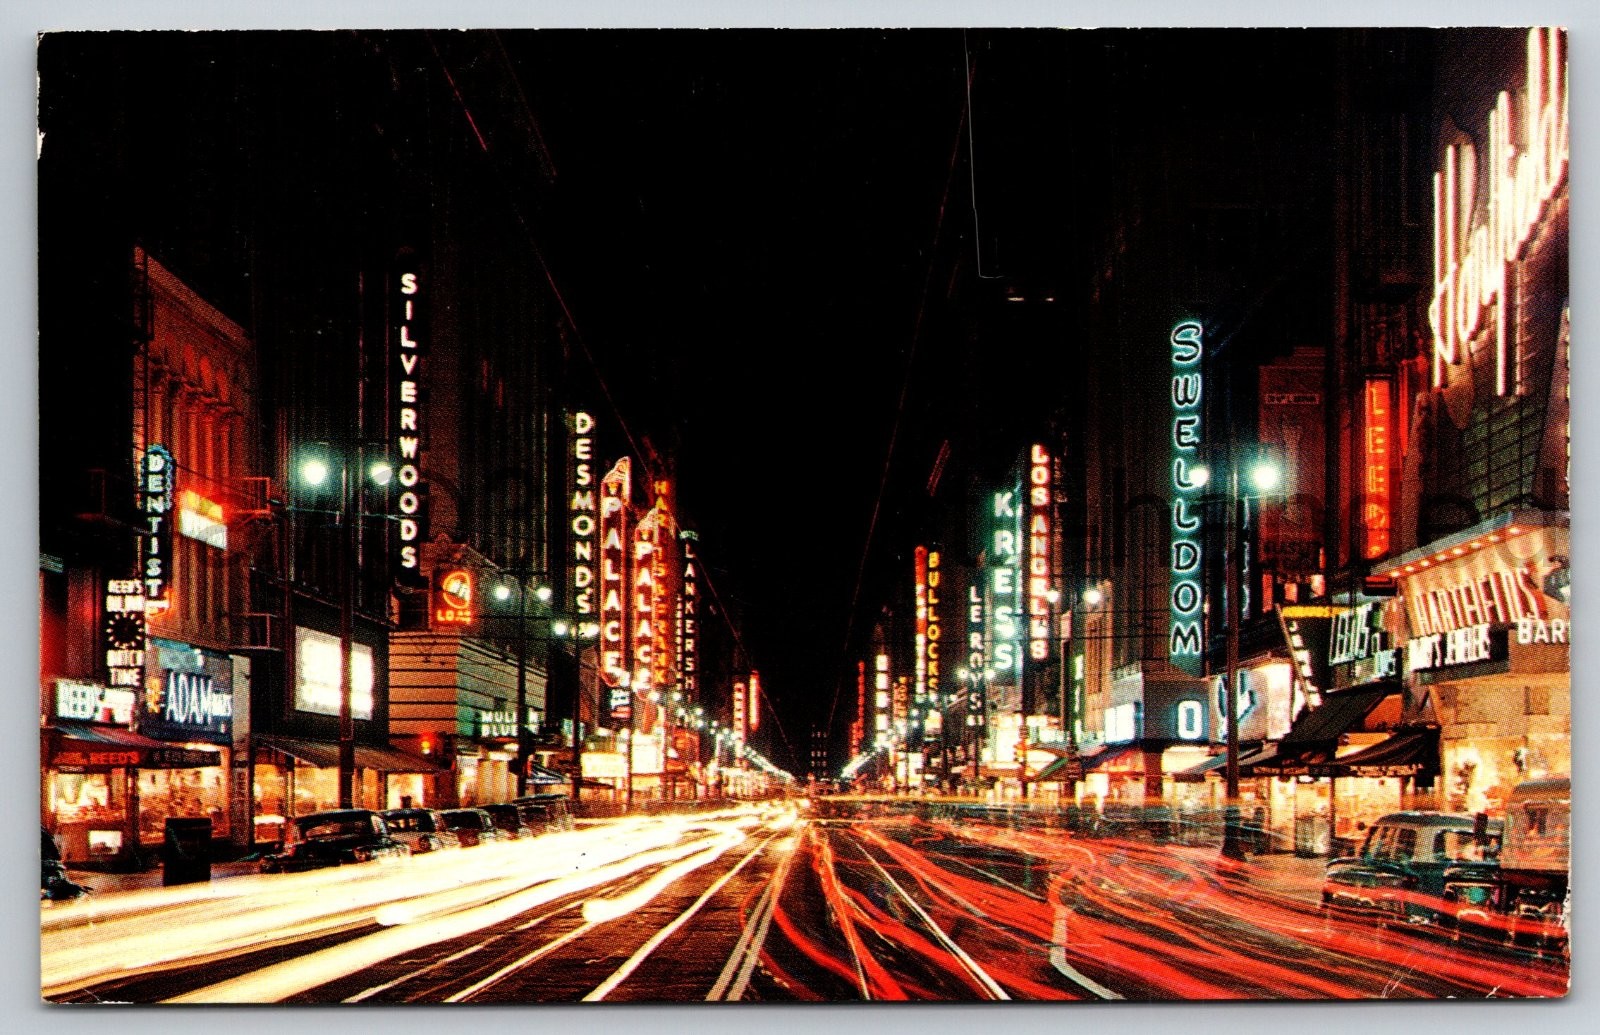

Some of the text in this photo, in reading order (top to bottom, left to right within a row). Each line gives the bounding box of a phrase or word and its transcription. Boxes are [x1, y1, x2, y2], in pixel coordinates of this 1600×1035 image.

[399, 272, 418, 568] SILVERWOODS
[1170, 321, 1203, 656] SWELLDOM
[145, 453, 166, 598] DENTIST
[571, 411, 597, 614] DESMOND'S
[601, 496, 622, 675] PALACE
[993, 492, 1014, 670] KRESS
[1030, 443, 1050, 660] LOS ANGELES
[166, 671, 213, 725] ADAM
[635, 540, 653, 688] PALACE
[684, 542, 697, 701] LANKERSHI
[1517, 618, 1570, 645] BAR
